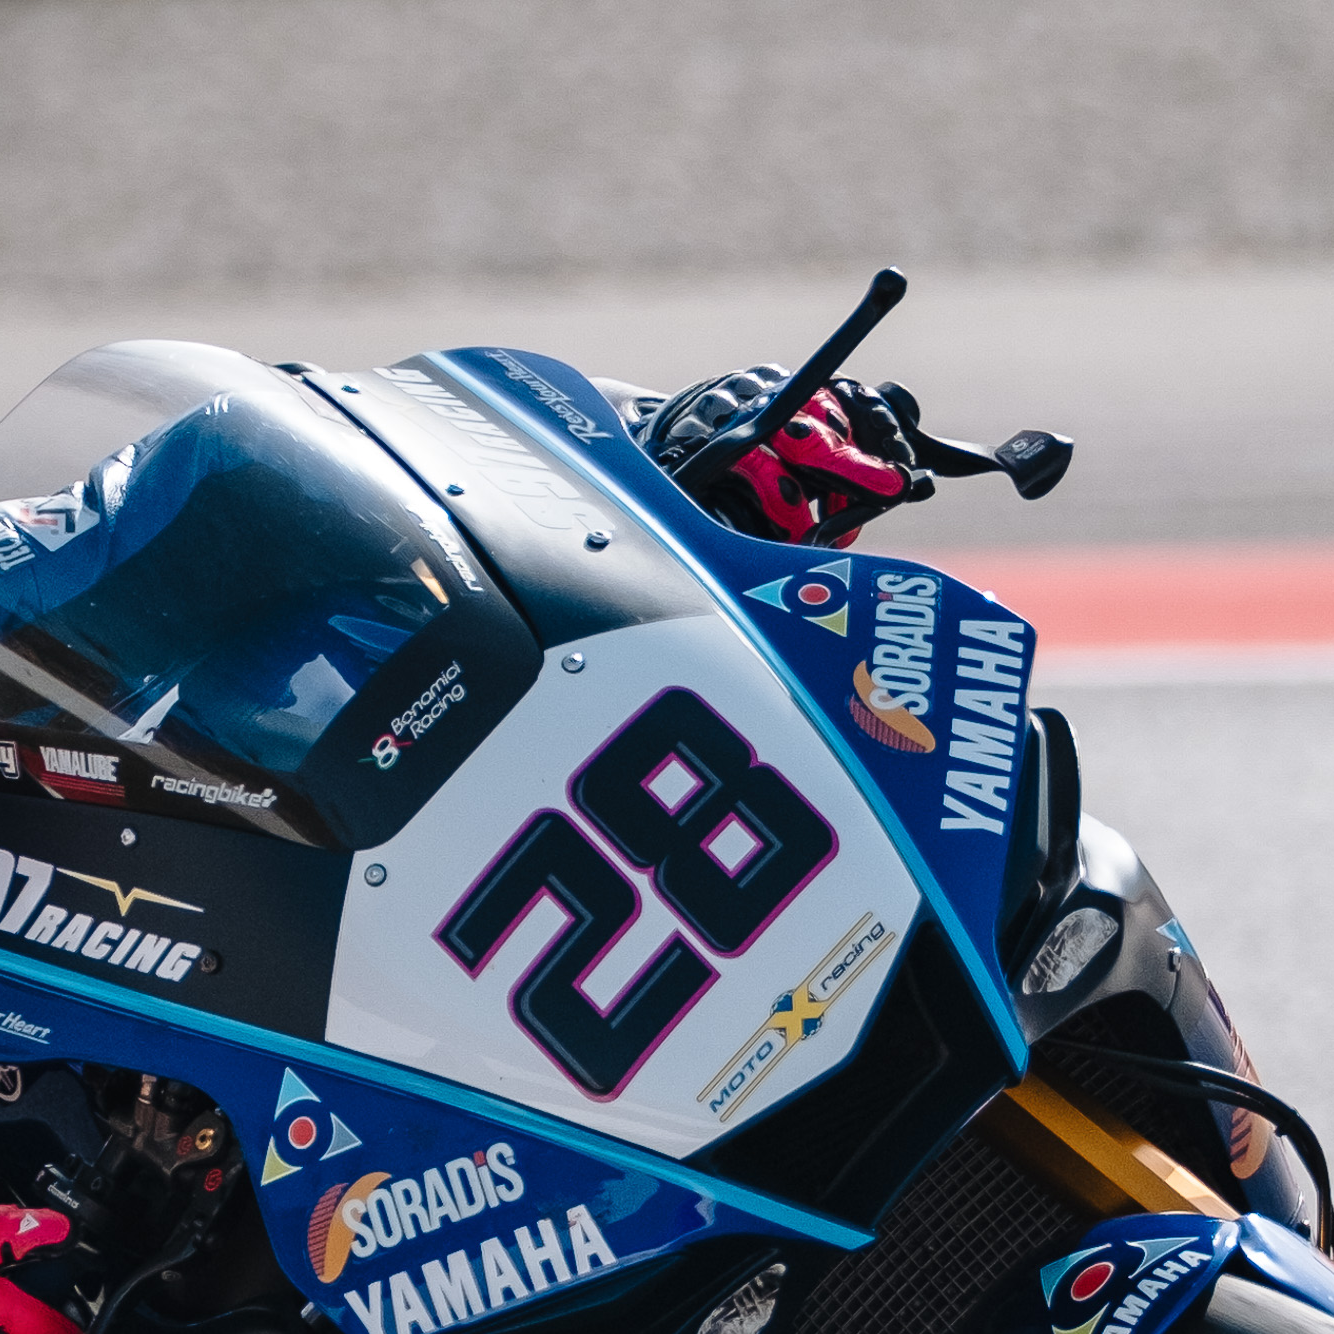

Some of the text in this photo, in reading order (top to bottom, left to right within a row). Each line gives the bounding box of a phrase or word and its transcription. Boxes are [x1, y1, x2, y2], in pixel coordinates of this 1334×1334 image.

[410, 683, 466, 740] Racing
[941, 618, 1026, 836] YAMAHA
[39, 746, 120, 783] YAMALUBE
[151, 773, 265, 808] racingbike
[432, 684, 839, 1103] 28
[24, 904, 203, 982] RACING
[0, 1011, 51, 1039] Heart
[709, 1038, 775, 1115] MOTO
[818, 918, 887, 993] racing
